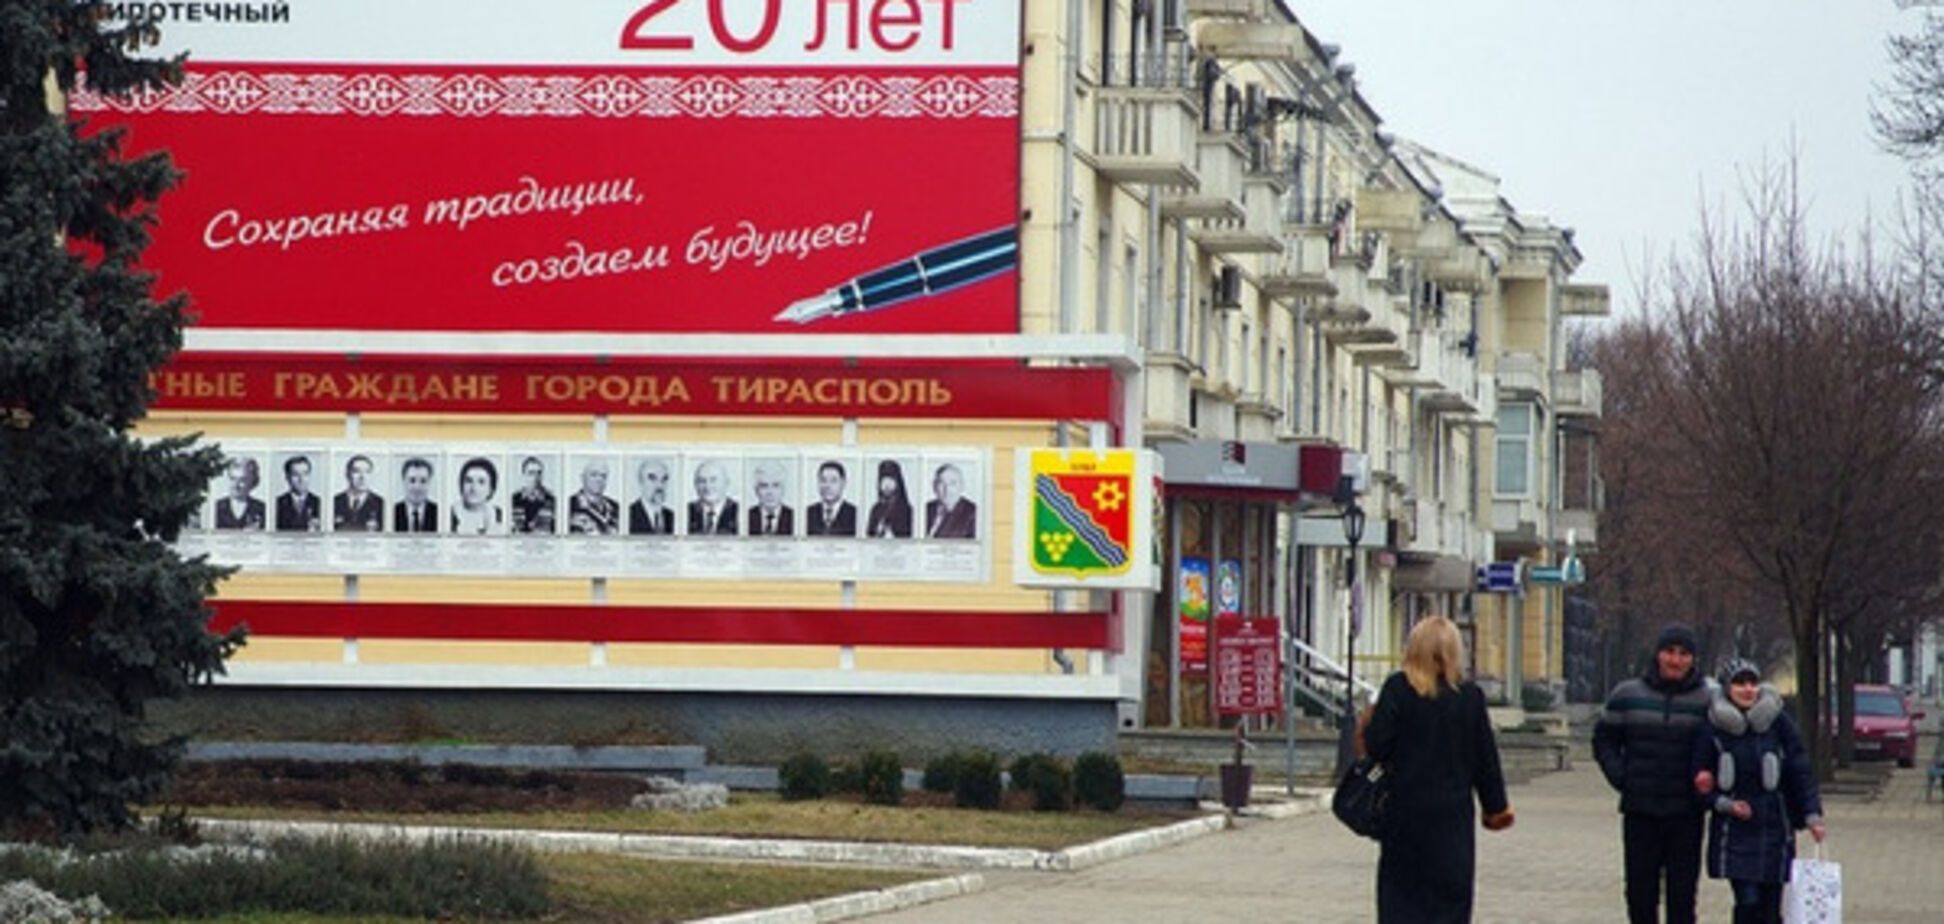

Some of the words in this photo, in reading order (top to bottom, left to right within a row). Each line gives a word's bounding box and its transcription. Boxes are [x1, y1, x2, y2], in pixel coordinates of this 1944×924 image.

[803, 0, 973, 52] лет
[203, 204, 409, 250] Сохраняя
[422, 175, 647, 231] традиции,
[491, 240, 671, 287] создаем
[685, 210, 874, 272] будущее!
[273, 372, 500, 405] ГРАЖДАНЕ
[525, 374, 691, 406] ГОРОДА
[711, 376, 953, 406] ТИРАСПОЛЬ
